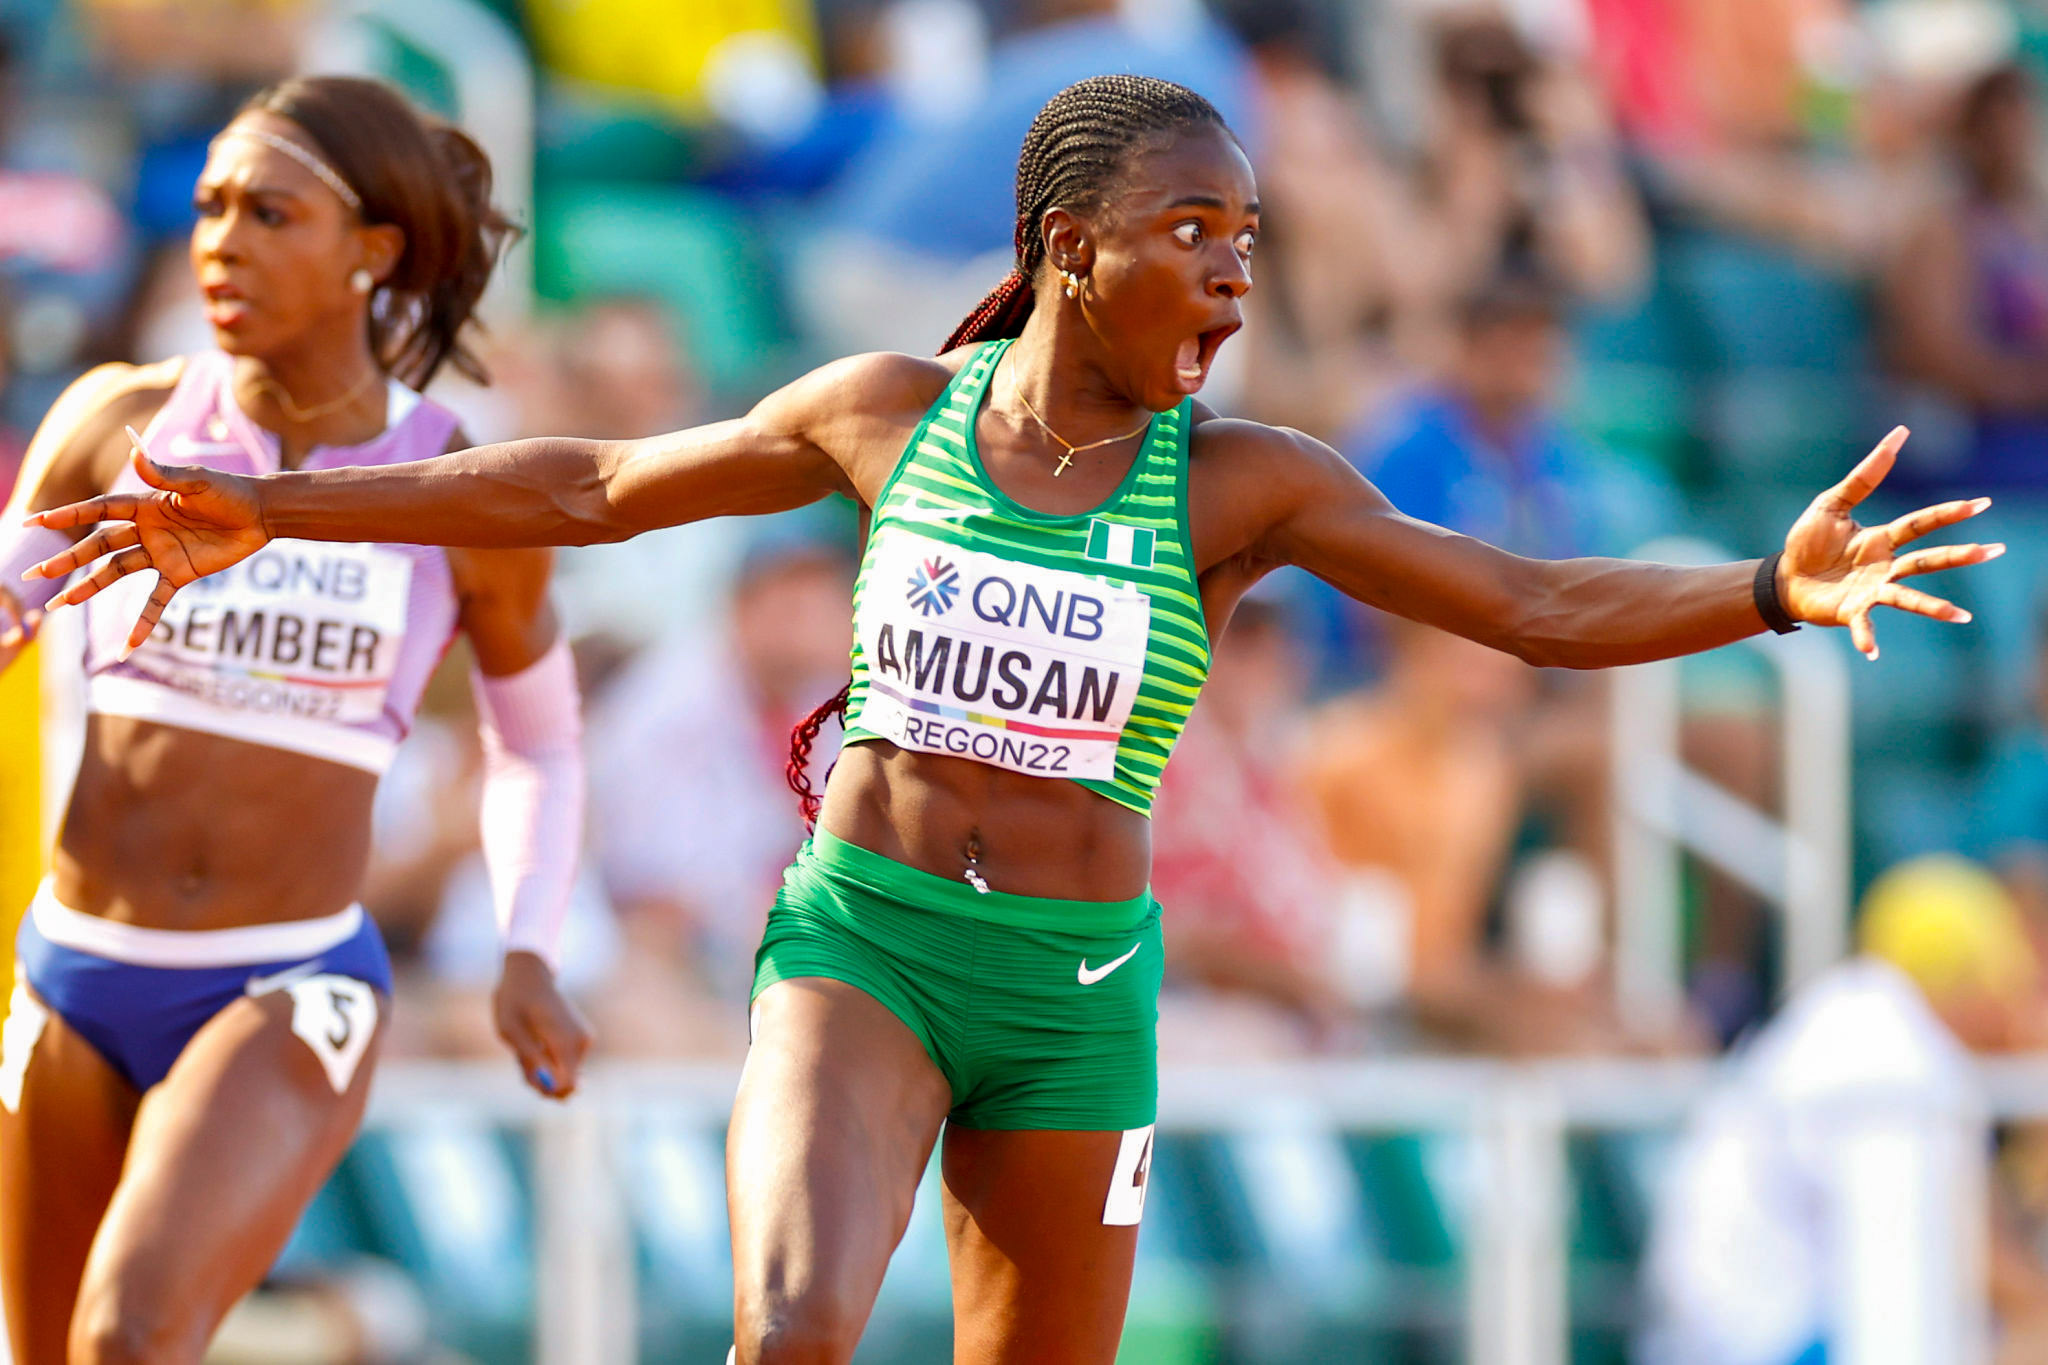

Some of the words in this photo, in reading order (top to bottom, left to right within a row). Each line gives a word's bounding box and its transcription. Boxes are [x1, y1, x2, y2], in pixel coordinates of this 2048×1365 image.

[247, 551, 368, 601] QNB
[149, 606, 381, 673] SEMBER
[972, 576, 1106, 641] QNB
[877, 623, 1119, 723] AMUSAN
[894, 711, 1071, 772] REGON22
[328, 990, 356, 1050] 5
